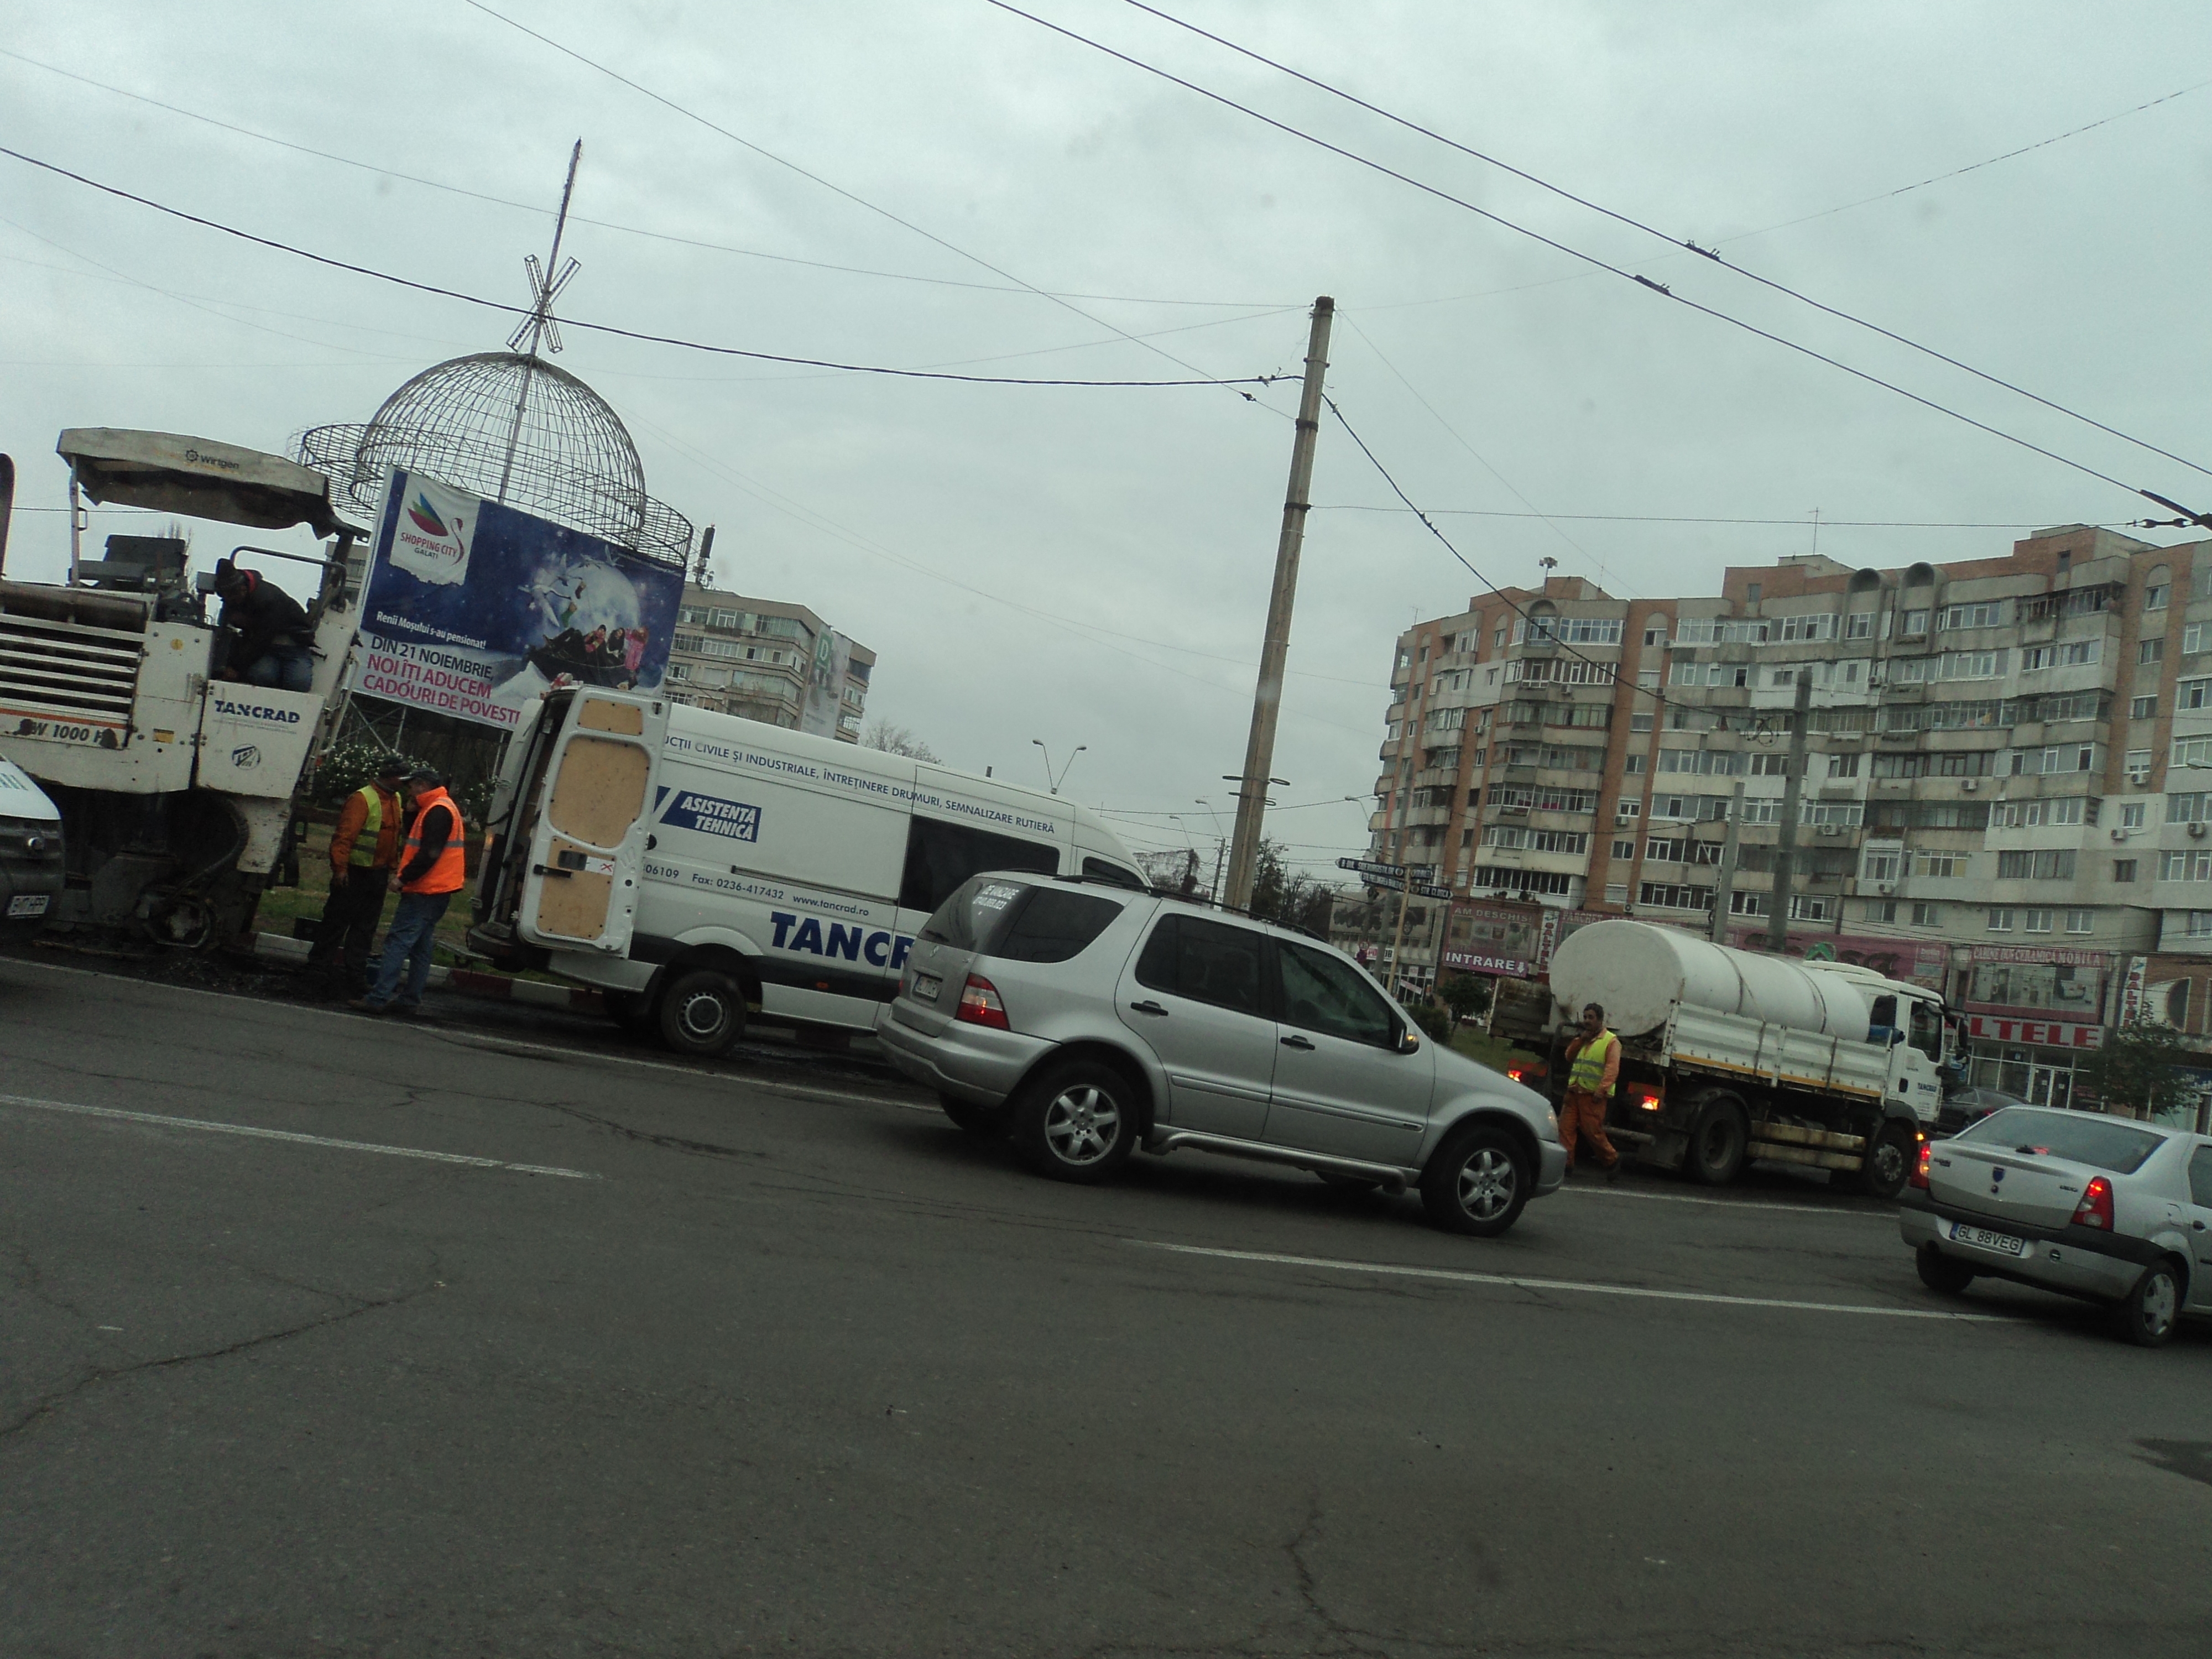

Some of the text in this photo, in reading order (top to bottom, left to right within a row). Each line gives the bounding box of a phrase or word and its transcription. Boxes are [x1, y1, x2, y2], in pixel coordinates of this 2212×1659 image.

[201, 455, 239, 469] Wirtgen
[400, 532, 458, 557] SHOPPING CITY
[377, 611, 398, 625] Renii
[430, 628, 446, 639] s-au
[446, 632, 486, 650] pensionat!
[371, 636, 493, 681] DIN 21 NOIEMBRIE,
[367, 654, 399, 676] NOI
[422, 669, 493, 699] ADUCEM
[363, 674, 436, 705] CADOURI
[437, 692, 458, 710] DE
[215, 700, 300, 723] TANCRAD
[53, 724, 90, 741] 1000
[695, 742, 729, 758] CIVILE
[745, 753, 820, 779] INDUSTRIALE,
[891, 787, 942, 808] DRUMURI,
[945, 800, 1014, 824] SEMNALIZARE
[695, 815, 754, 840] TEHNICĂ
[644, 864, 869, 916] 06109 Fax: 0236-417432 www.tancrad.ro
[1454, 907, 1532, 922] AM DESCHIS!
[1446, 952, 1515, 971] INTRARE
[1958, 1226, 1971, 1240] GL
